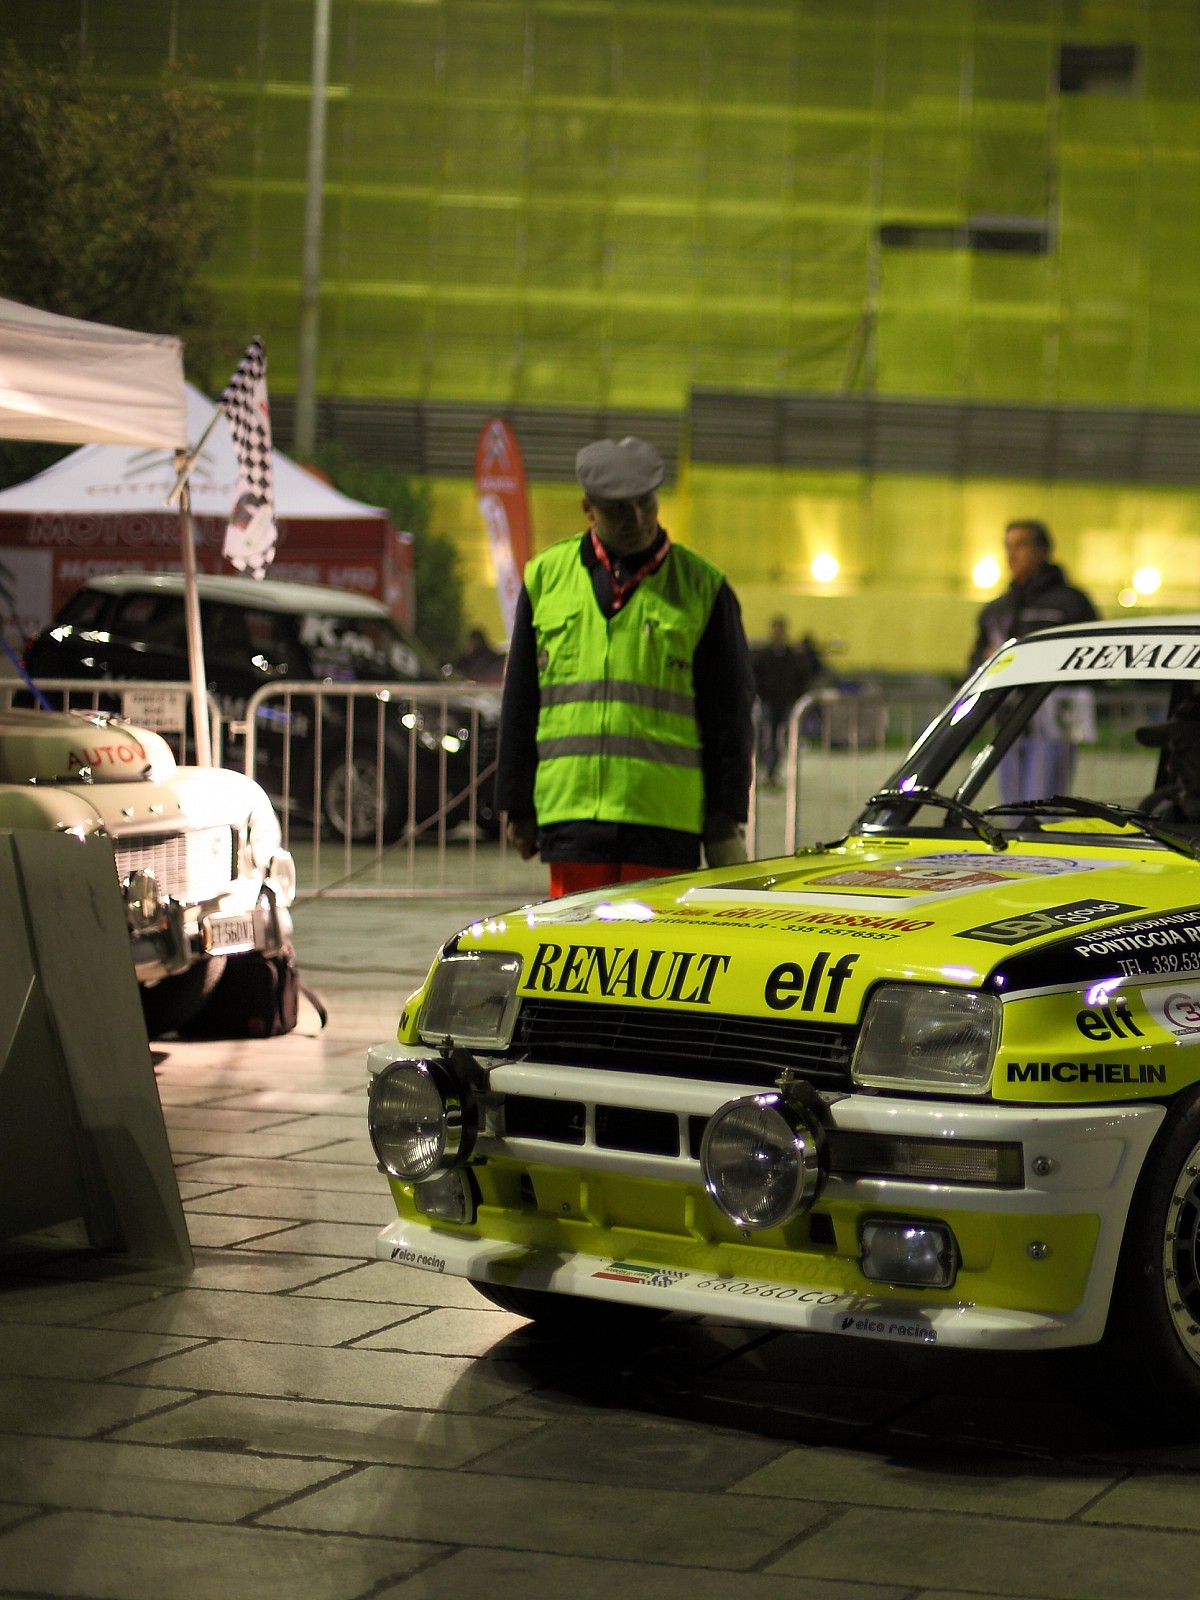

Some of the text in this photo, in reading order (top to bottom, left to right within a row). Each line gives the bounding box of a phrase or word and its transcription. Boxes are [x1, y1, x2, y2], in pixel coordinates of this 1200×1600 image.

[713, 908, 810, 922] GRITTI
[797, 912, 936, 933] ROSSANO
[780, 924, 818, 933] 335
[818, 926, 902, 941] 6576557
[523, 942, 731, 1006] RENAULT
[763, 951, 861, 1014] elf
[1075, 993, 1146, 1042] elf
[1007, 1062, 1167, 1084] MICHELIN
[417, 1250, 446, 1273] racing
[888, 1322, 938, 1344] racing
